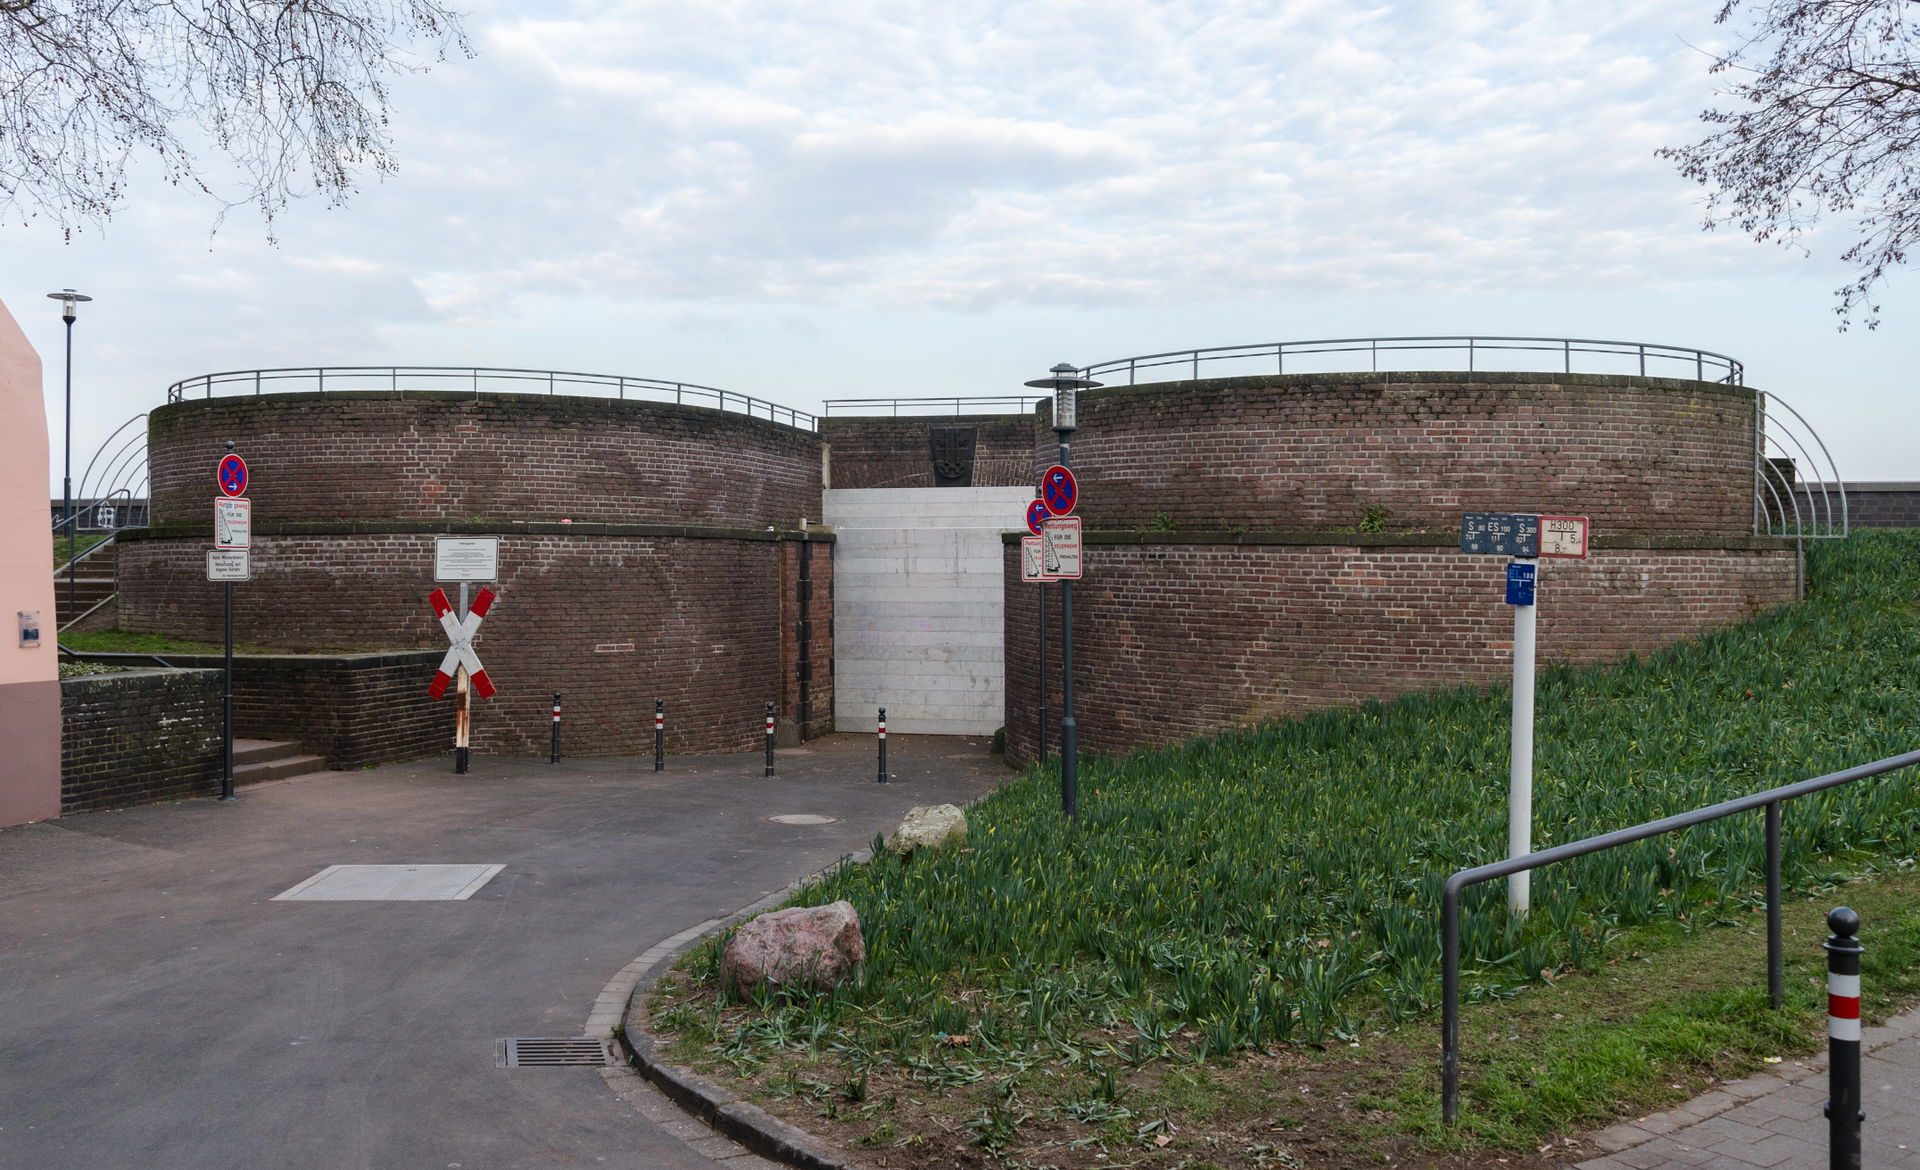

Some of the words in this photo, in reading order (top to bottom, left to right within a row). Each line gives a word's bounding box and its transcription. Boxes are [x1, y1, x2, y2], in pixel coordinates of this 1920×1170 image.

[1044, 522, 1077, 531] Rettungsweg
[1468, 520, 1474, 531] S
[1488, 522, 1499, 532] ES
[1519, 523, 1525, 533] S
[1550, 520, 1574, 530] H300
